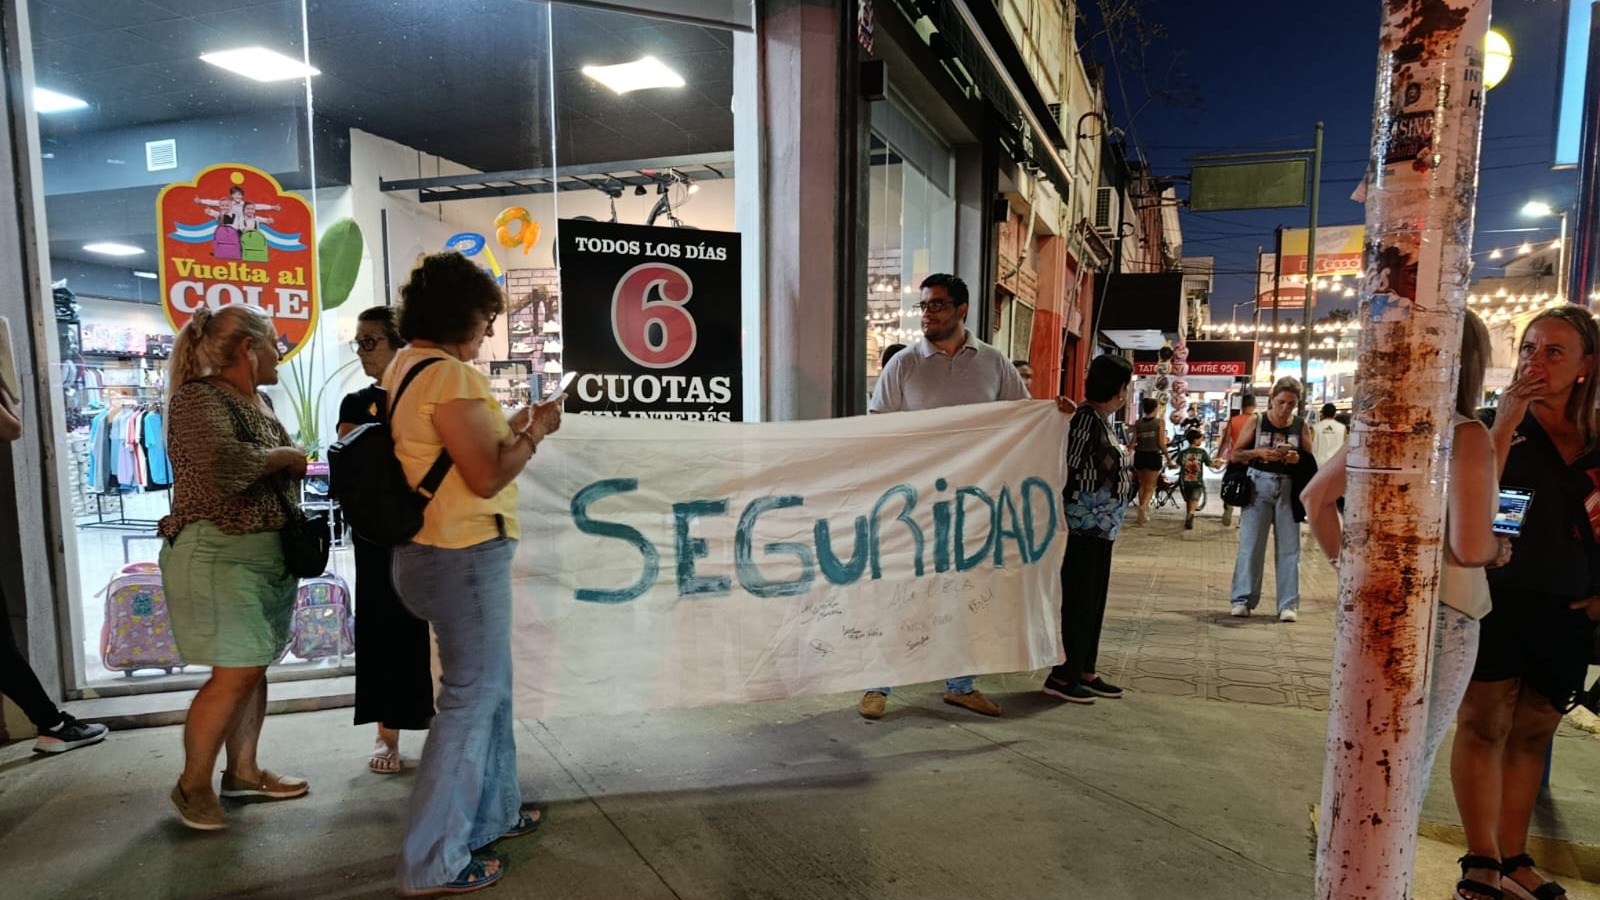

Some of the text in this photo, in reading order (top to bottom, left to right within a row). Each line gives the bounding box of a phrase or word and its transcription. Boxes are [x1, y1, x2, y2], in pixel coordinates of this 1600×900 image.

[575, 237, 727, 261] TODOS LOS DÍAS
[171, 257, 306, 285] Vuelta al
[170, 281, 309, 319] COLE
[611, 262, 697, 369] 6
[1191, 364, 1218, 373] MITRE
[1220, 364, 1240, 373] 950
[577, 373, 732, 404] CUOTAS
